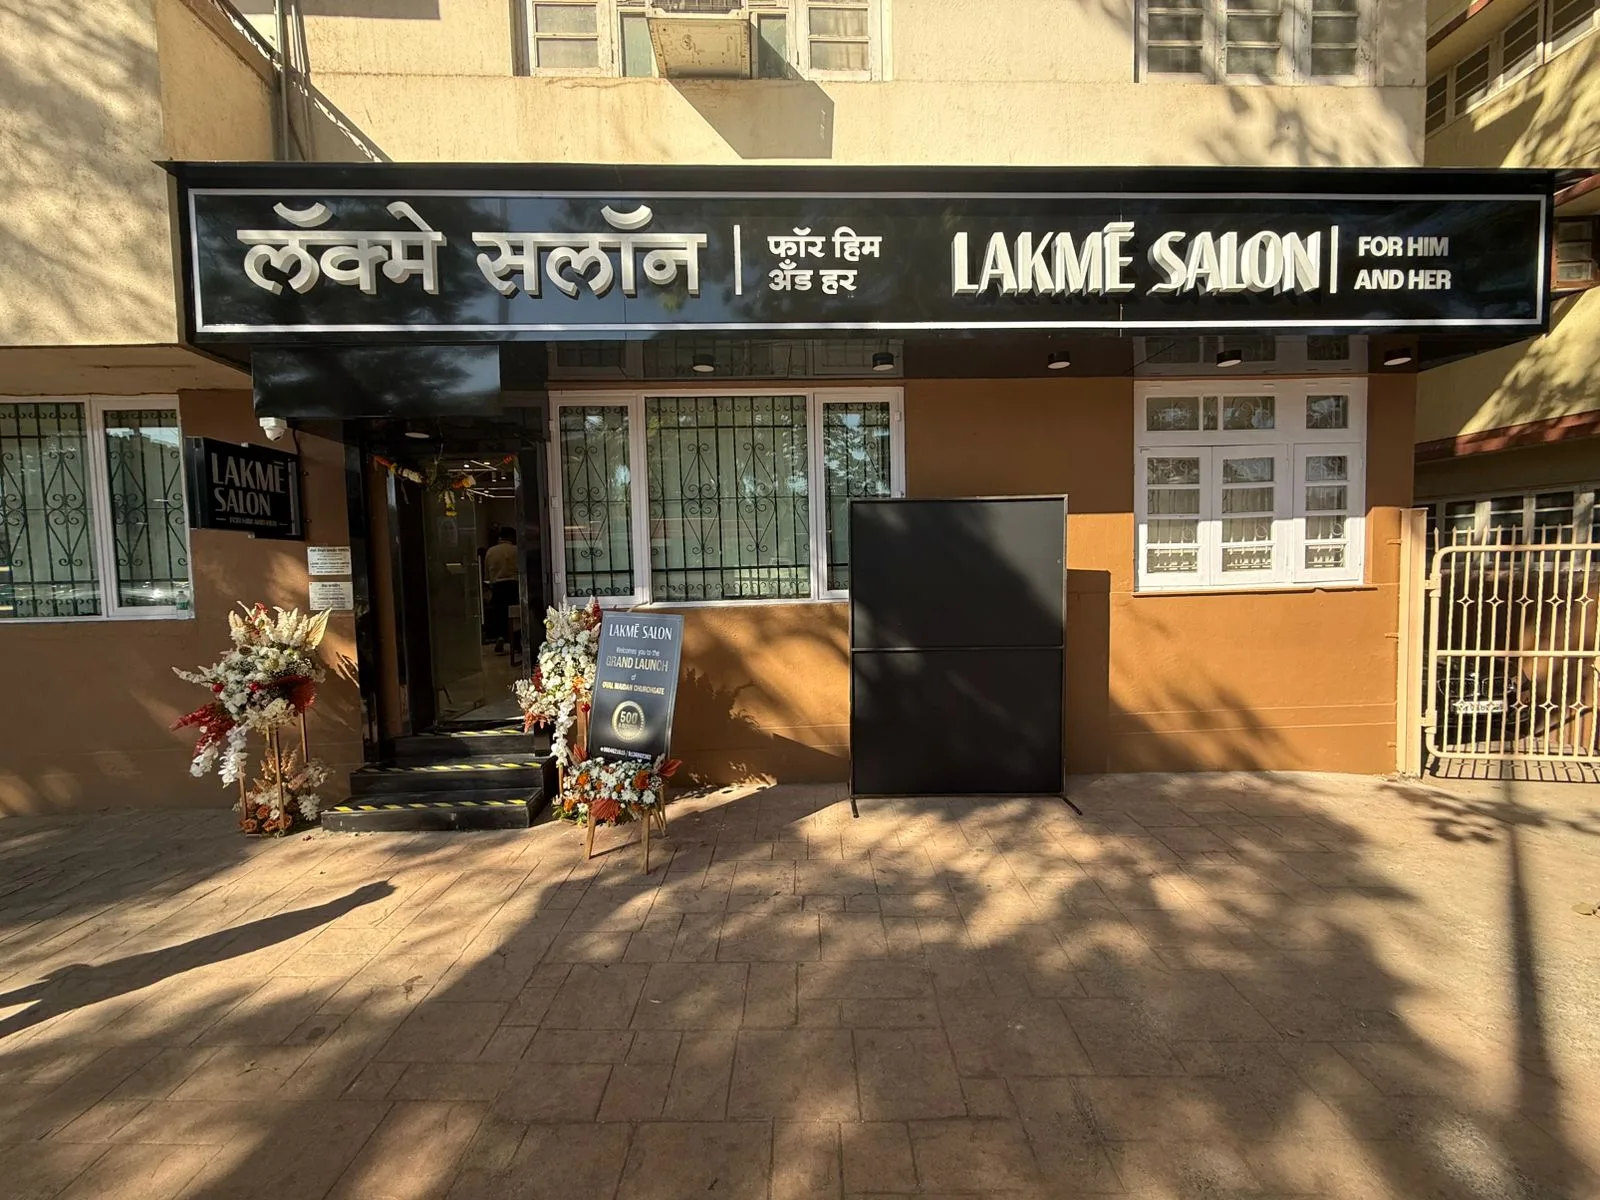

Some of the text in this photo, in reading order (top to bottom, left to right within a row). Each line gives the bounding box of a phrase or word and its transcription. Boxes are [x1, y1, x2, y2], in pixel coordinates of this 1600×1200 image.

[472, 204, 707, 297] सलॉन
[767, 226, 882, 261] फॉर हिम
[1358, 235, 1449, 257] FOR HIM
[1146, 230, 1321, 297] SALON
[819, 269, 858, 295] हर
[1353, 269, 1452, 290] AND HER
[214, 486, 272, 517] SALON
[642, 625, 673, 641] SALON
[605, 655, 669, 672] GRAND LAUNCH
[620, 710, 638, 724] 500
